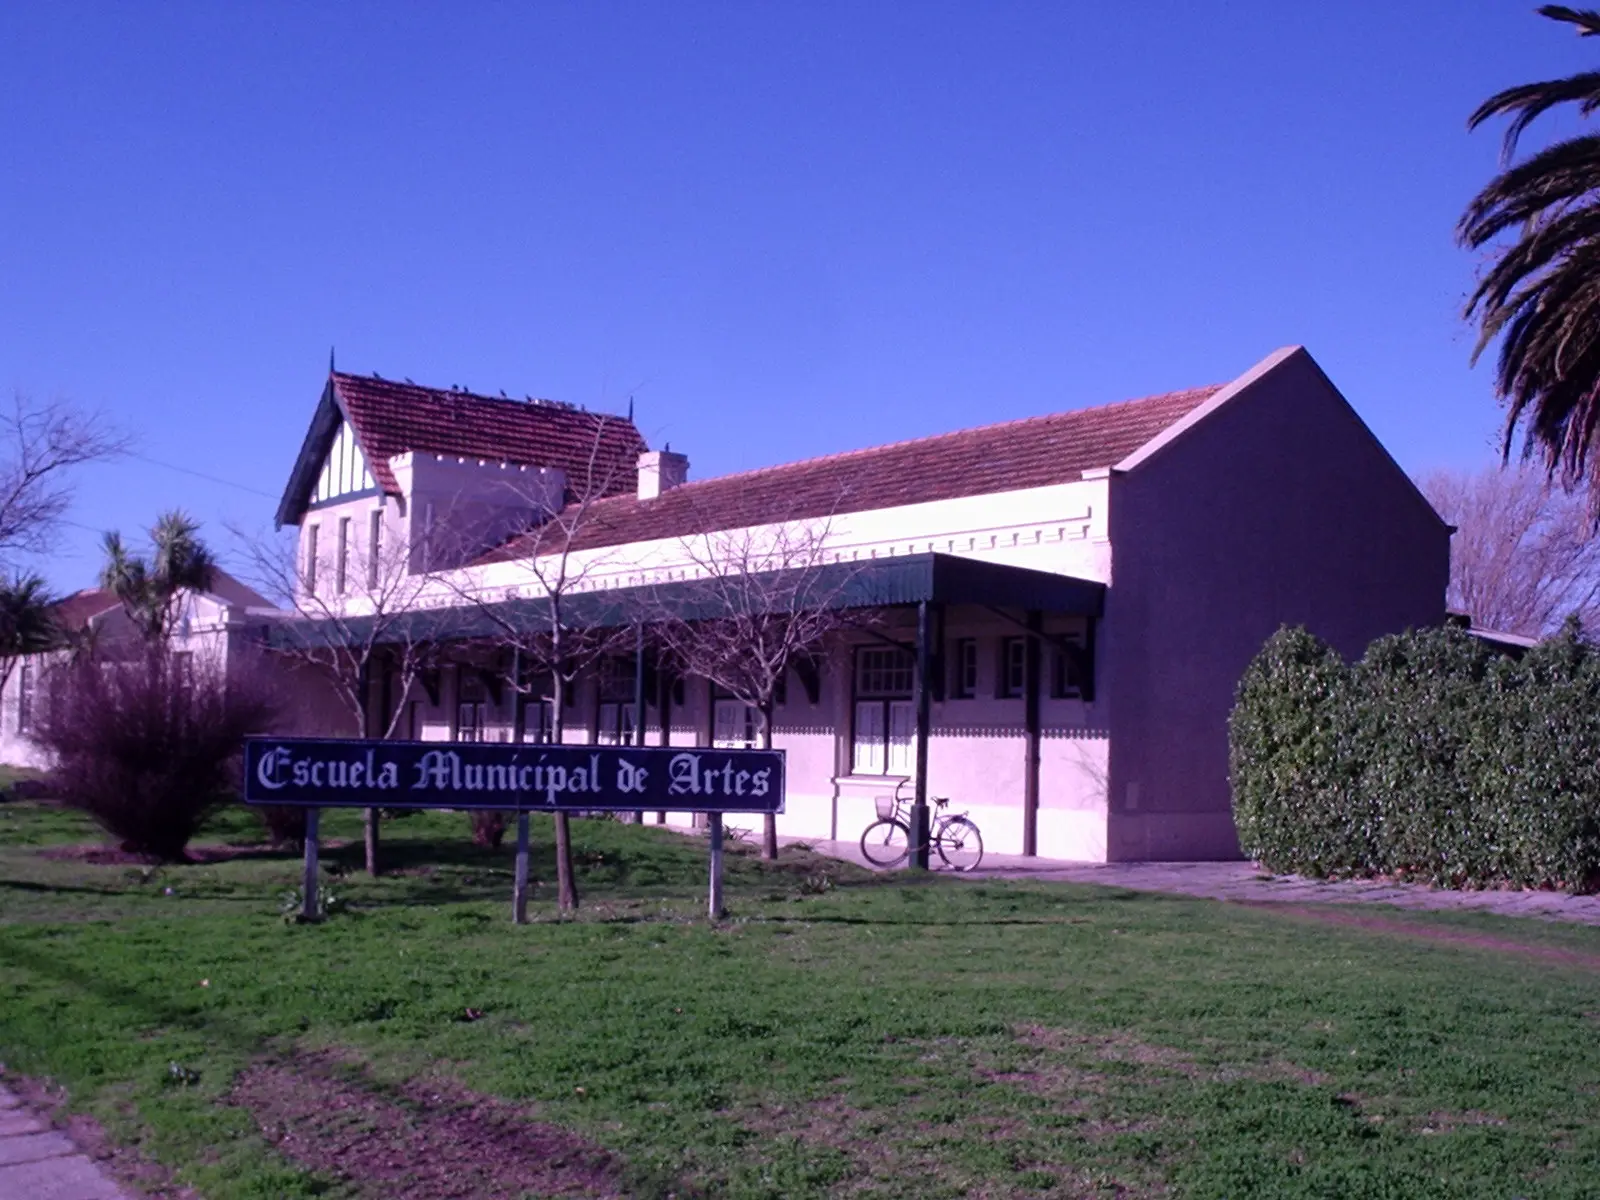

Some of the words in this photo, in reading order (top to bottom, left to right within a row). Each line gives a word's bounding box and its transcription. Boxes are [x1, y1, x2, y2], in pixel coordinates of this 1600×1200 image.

[256, 747, 399, 791] Escuela
[411, 750, 602, 804] Municipal
[616, 757, 649, 794] de
[667, 752, 771, 798] Artes
